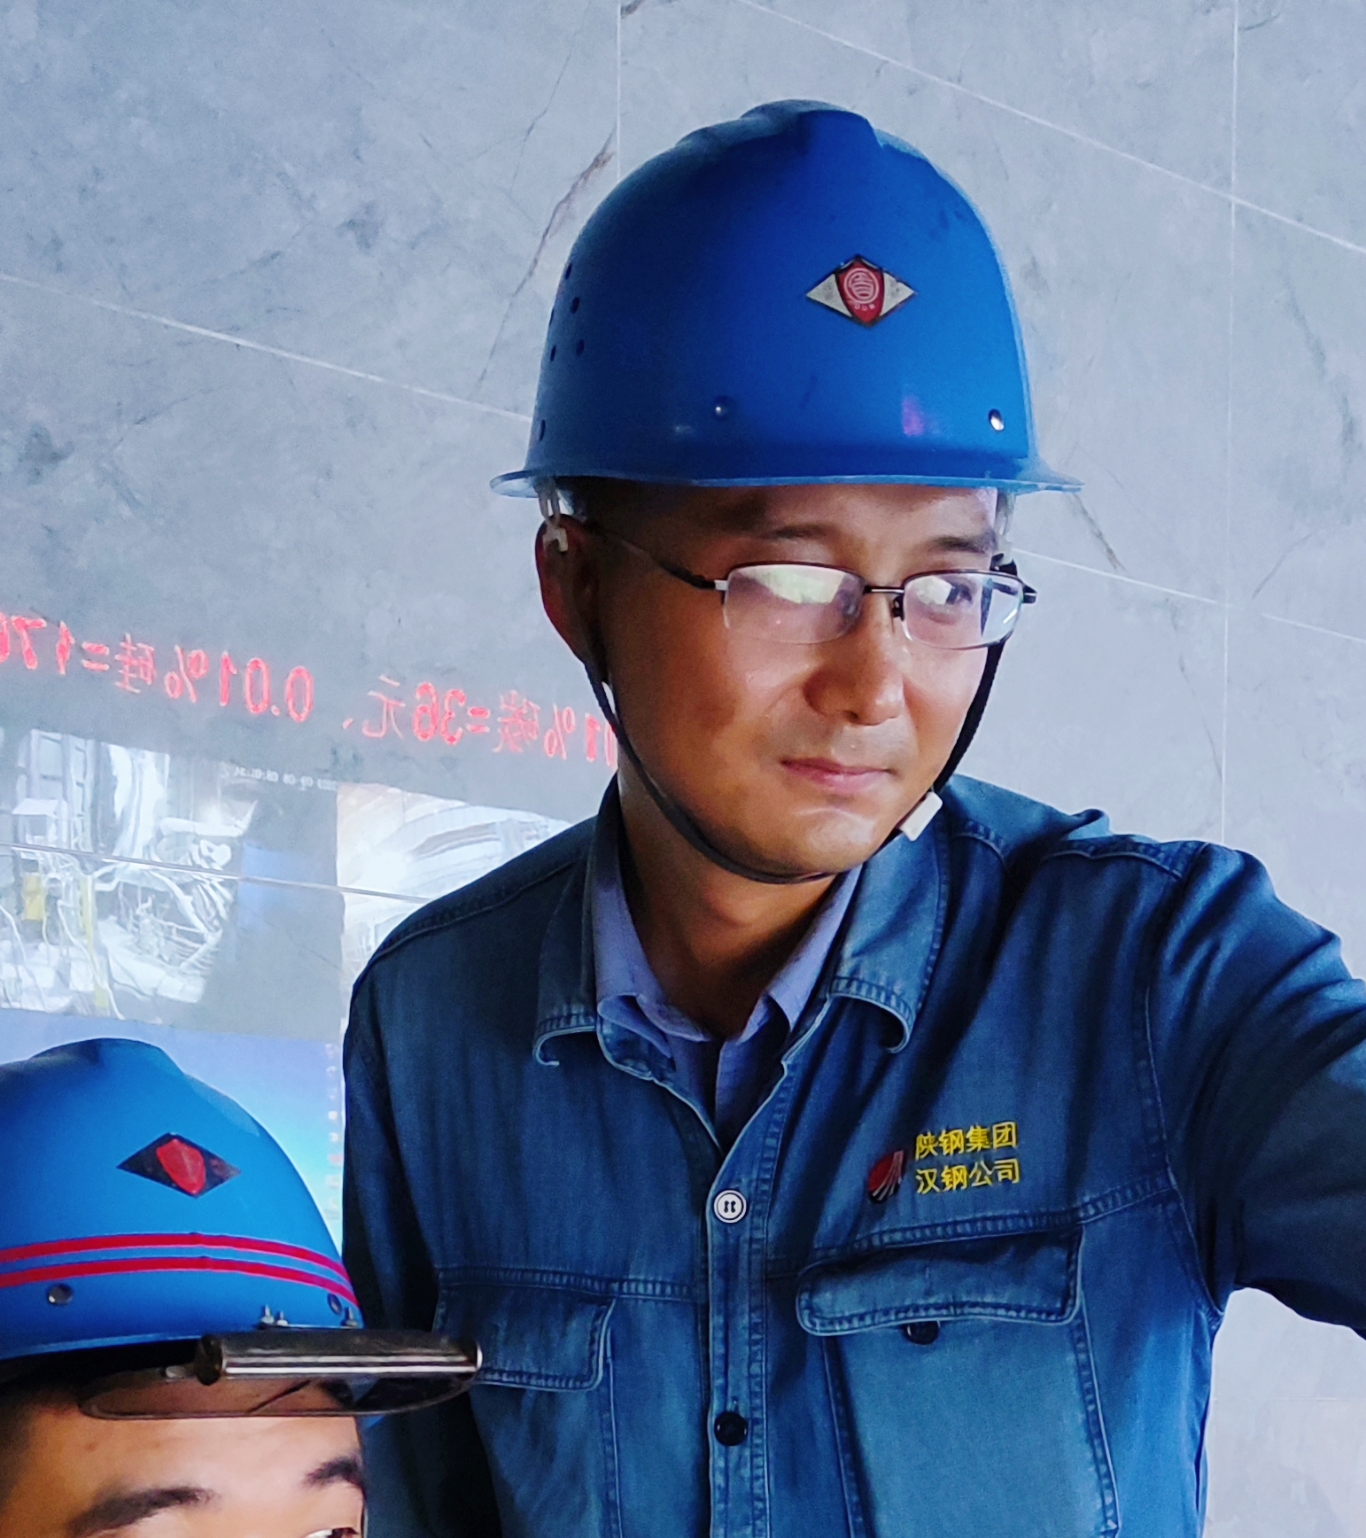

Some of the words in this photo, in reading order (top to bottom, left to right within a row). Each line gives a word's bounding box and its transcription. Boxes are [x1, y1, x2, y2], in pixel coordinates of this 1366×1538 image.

[915, 1121, 1018, 1161] 陕钢集团
[915, 1157, 1021, 1195] 汉钢公司
